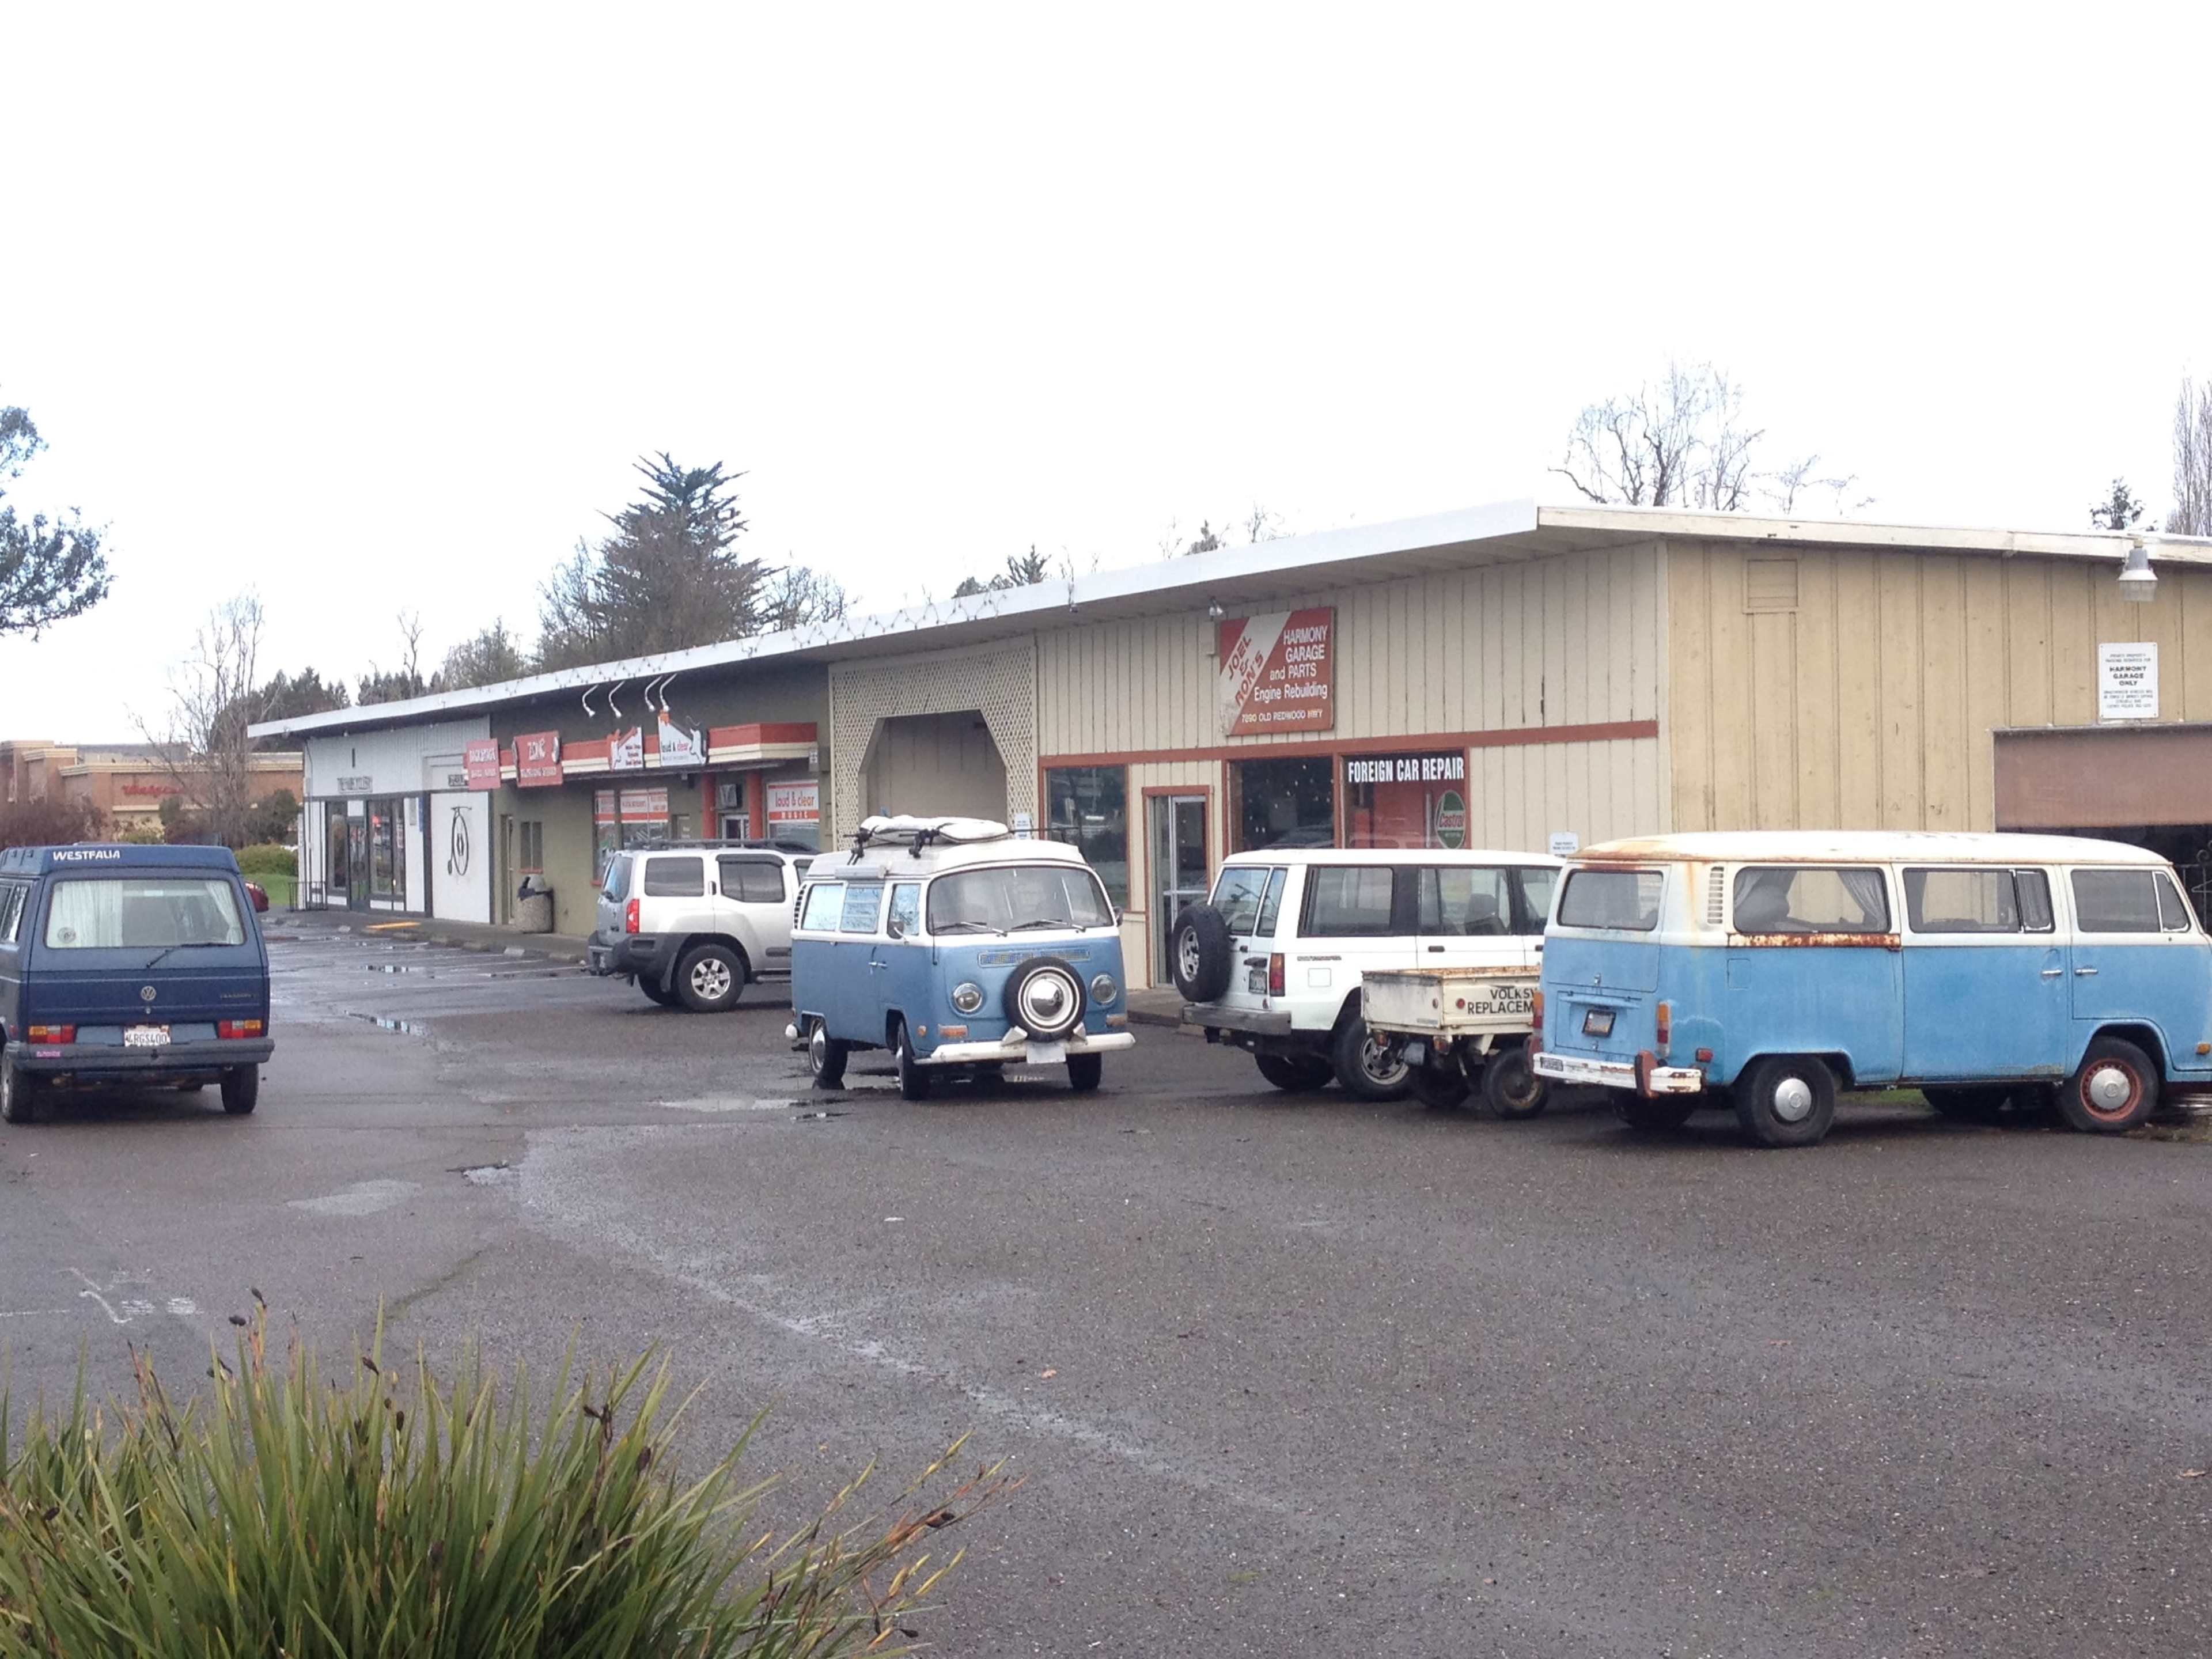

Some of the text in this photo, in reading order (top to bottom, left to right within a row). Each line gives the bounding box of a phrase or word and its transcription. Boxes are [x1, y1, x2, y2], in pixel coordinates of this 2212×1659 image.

[1283, 626, 1328, 645] HARMONY
[1228, 635, 1252, 680] JOEL
[1286, 645, 1324, 662] GARAGE
[1270, 662, 1316, 680] and PARTS
[1254, 681, 1328, 703] Engine Rebuilding
[1259, 712, 1271, 721] OLD
[1348, 757, 1464, 783] FOREIGN CAR REPAIR
[775, 791, 789, 807] loud
[781, 811, 808, 819] MUSIC
